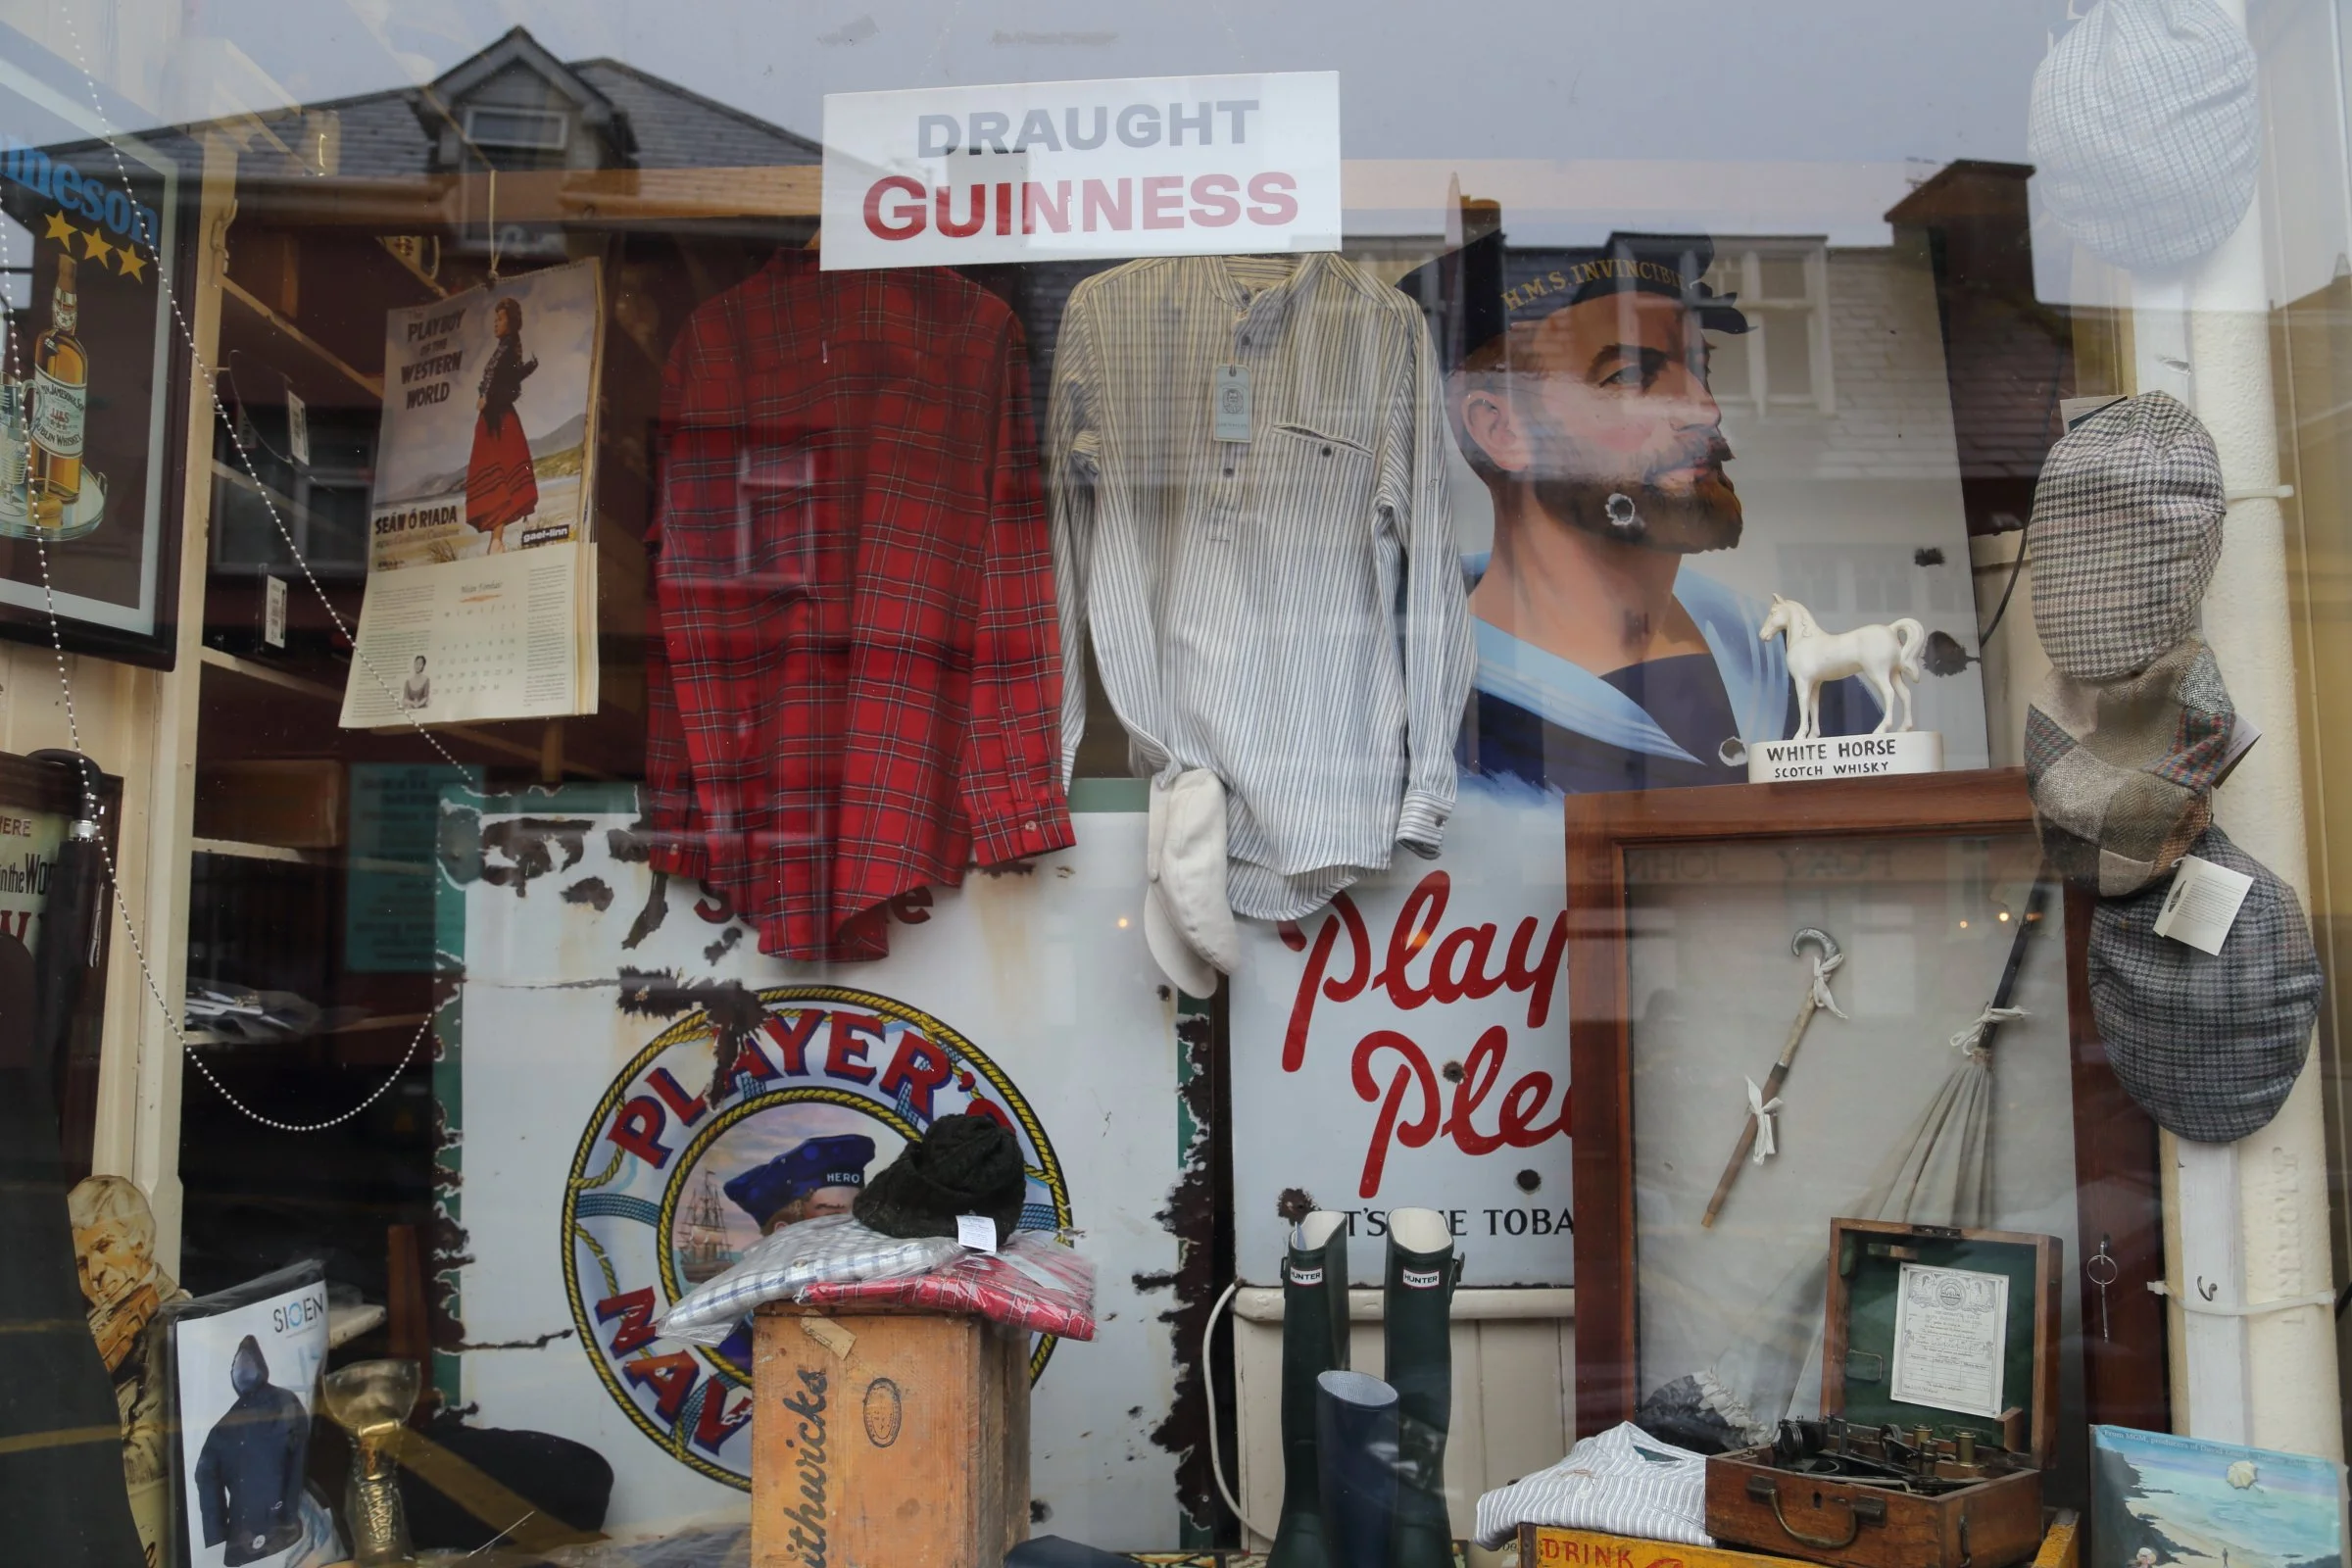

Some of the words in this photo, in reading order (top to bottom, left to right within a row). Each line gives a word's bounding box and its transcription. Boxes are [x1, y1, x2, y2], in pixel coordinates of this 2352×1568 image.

[918, 100, 1259, 159] DRAUGHT
[862, 171, 1299, 241] GUINNESS
[401, 350, 463, 384] WESTERN
[407, 382, 450, 409] WORLD
[419, 505, 458, 529] RIADA
[523, 527, 568, 544] gael-linn
[1767, 744, 1828, 762] WHITE
[1838, 739, 1896, 759] HORSE
[1775, 765, 1823, 778] SCOTCH
[1833, 761, 1889, 775] WHISKY
[826, 1173, 860, 1184] HERO
[1404, 1274, 1438, 1284] HUNTER
[273, 1293, 323, 1333] SIOEN
[2103, 1430, 2125, 1440] From
[2125, 1432, 2148, 1444] MGM,
[2150, 1437, 2189, 1449] producers
[1542, 1538, 1634, 1568] DRINK
